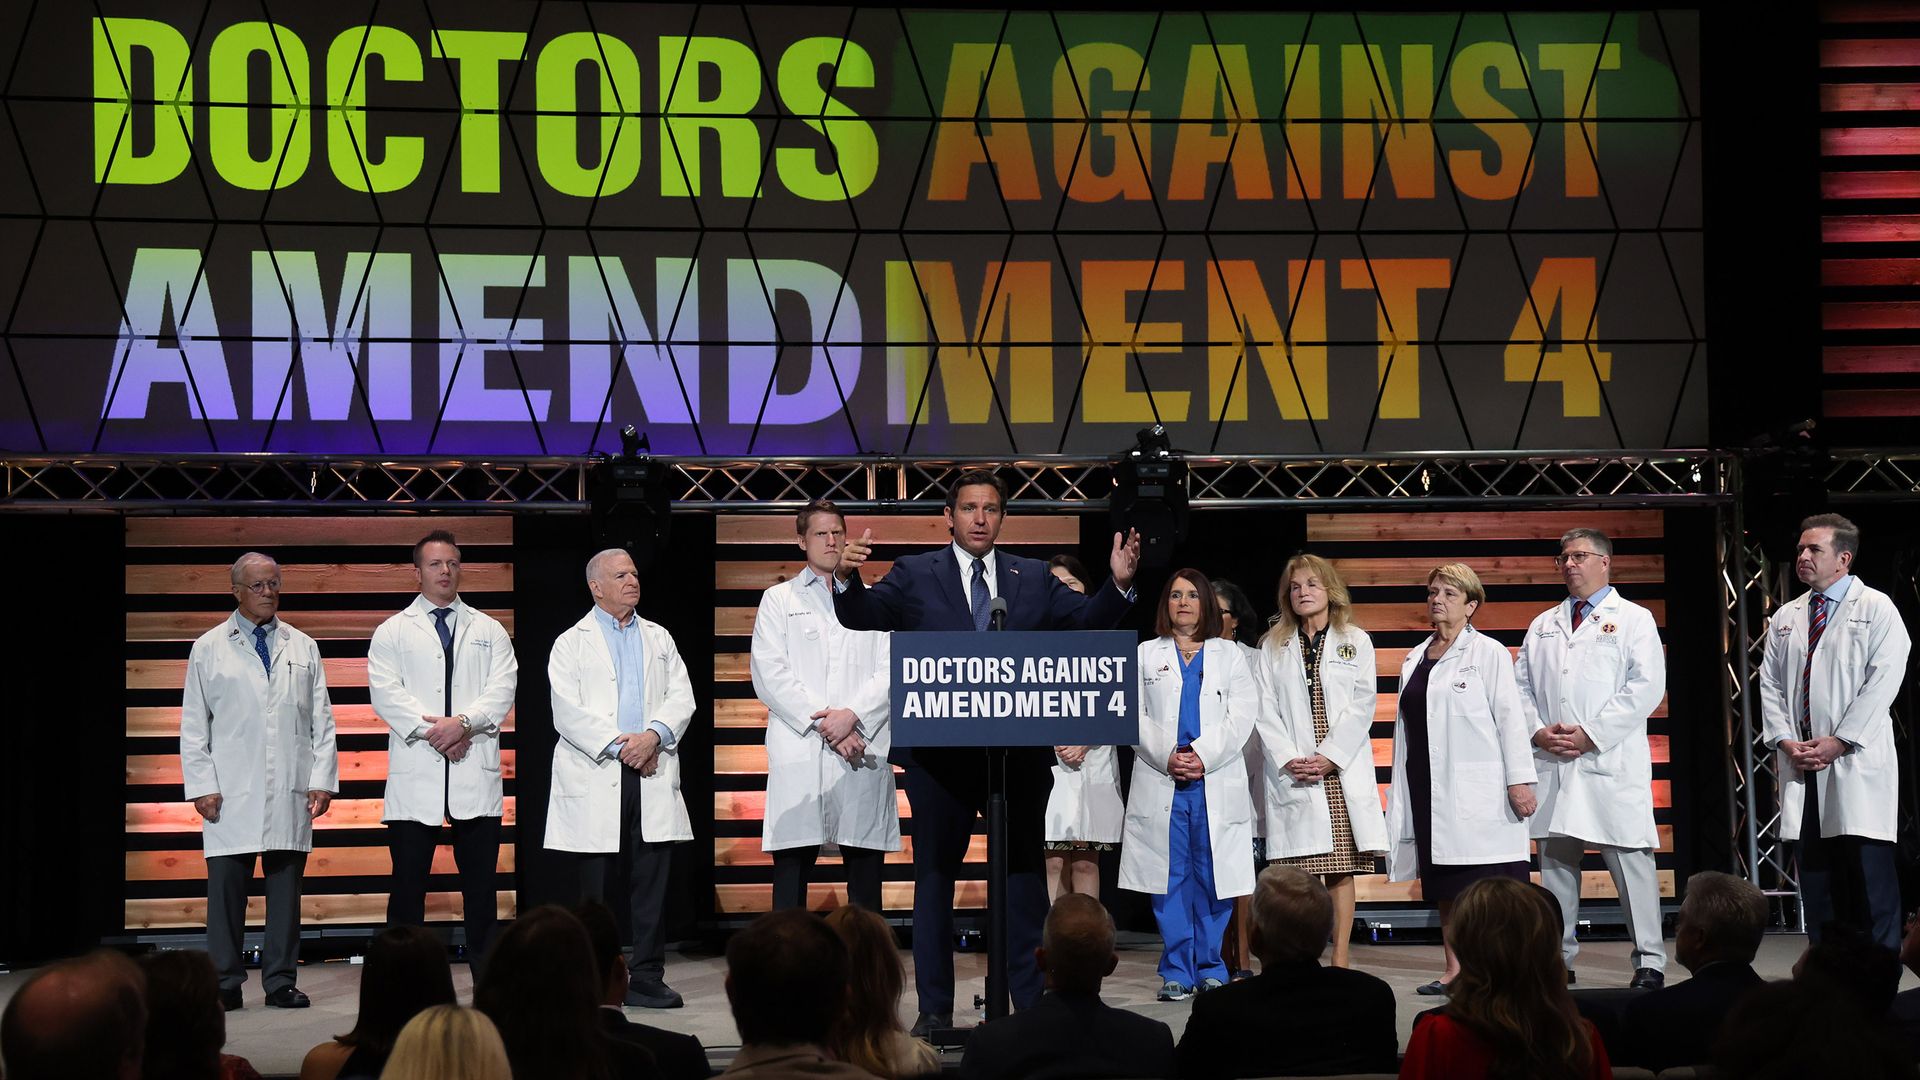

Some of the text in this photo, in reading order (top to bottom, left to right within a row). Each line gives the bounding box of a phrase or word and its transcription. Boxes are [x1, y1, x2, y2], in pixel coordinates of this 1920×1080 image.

[92, 17, 1621, 202] DOCTORS AGAINST
[101, 247, 1612, 425] AMENDMENT 4
[902, 656, 1127, 685] DOCTORS AGAINST
[902, 690, 1127, 718] AMENDMENT 4
